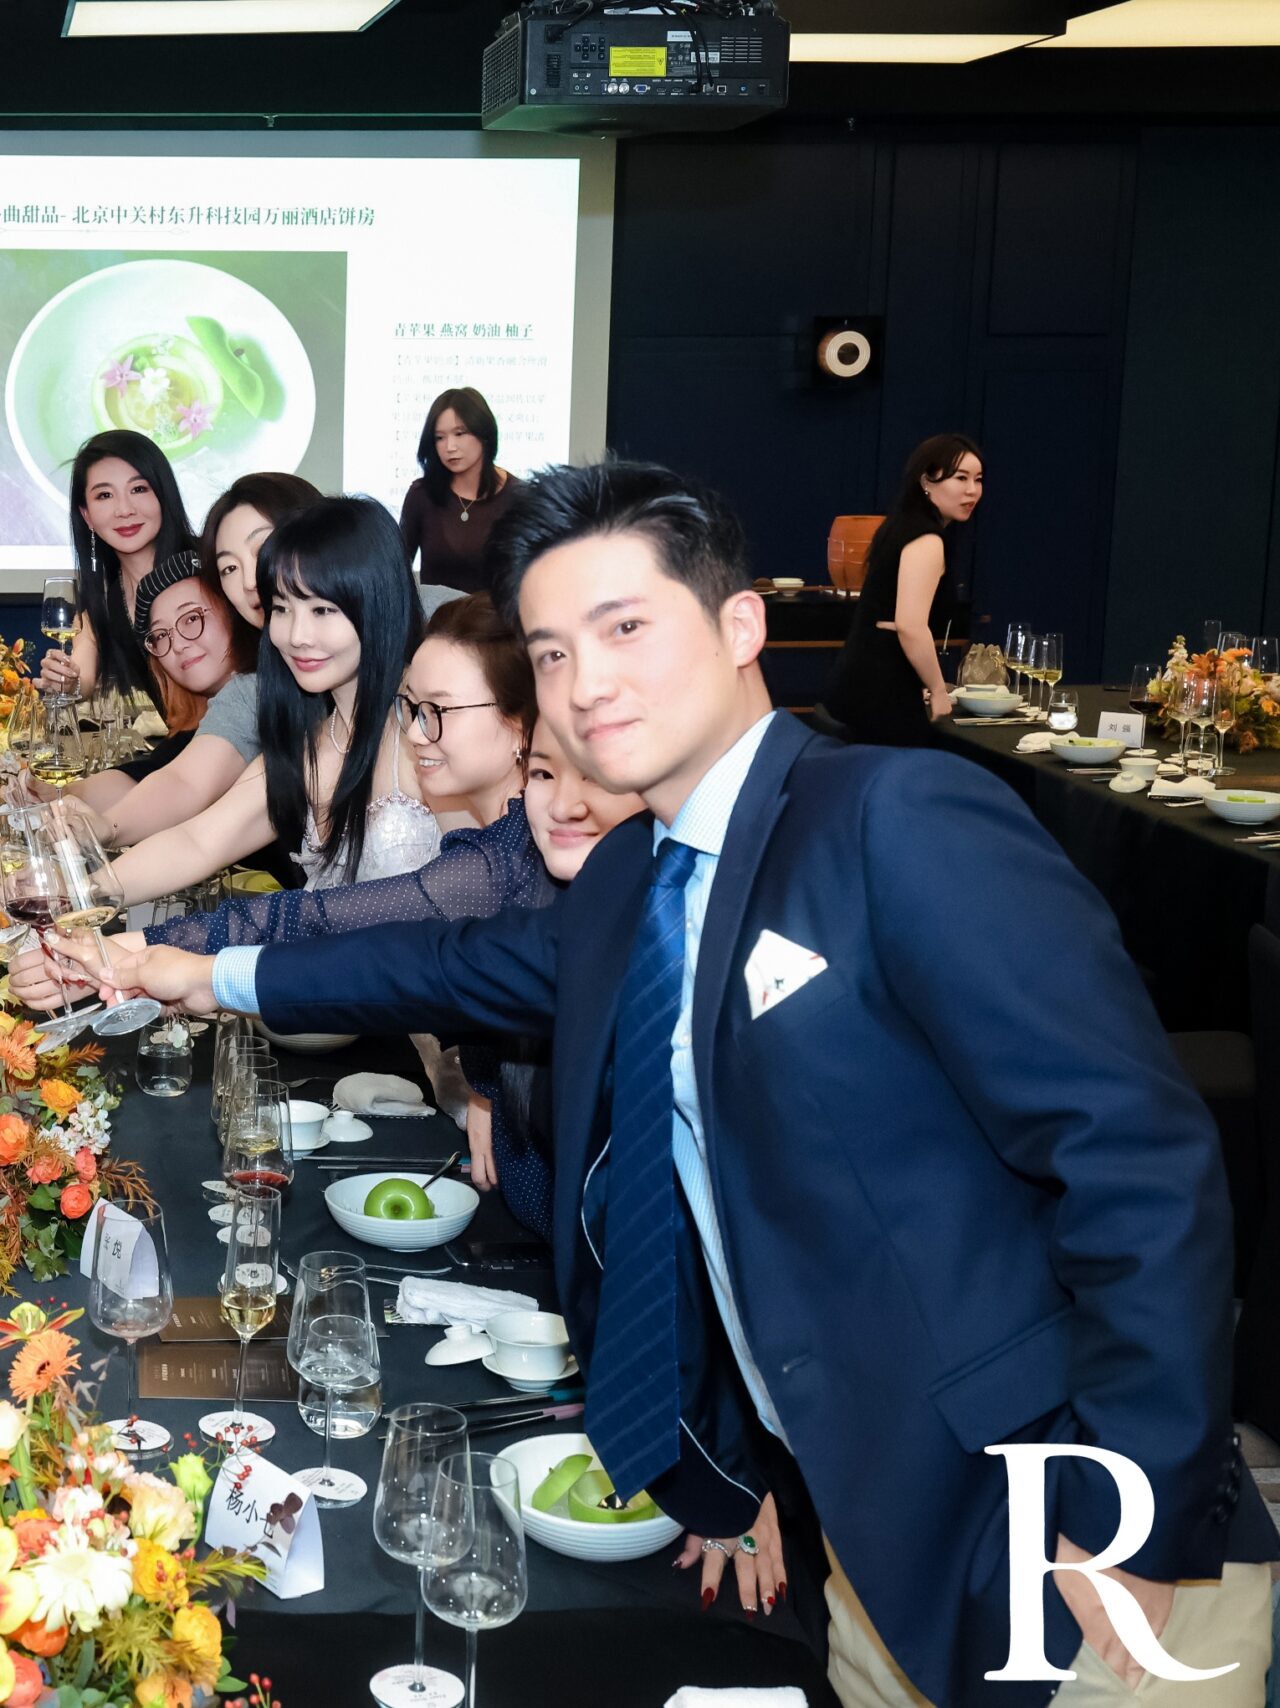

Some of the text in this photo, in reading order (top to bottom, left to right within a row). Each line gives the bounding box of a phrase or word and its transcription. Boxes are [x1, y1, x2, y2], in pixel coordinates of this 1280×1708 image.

[71, 205, 375, 226] 北京中关村东升科技园万丽酒店饼房
[394, 322, 534, 338] 青苹果 燕窝 奶油 柚子
